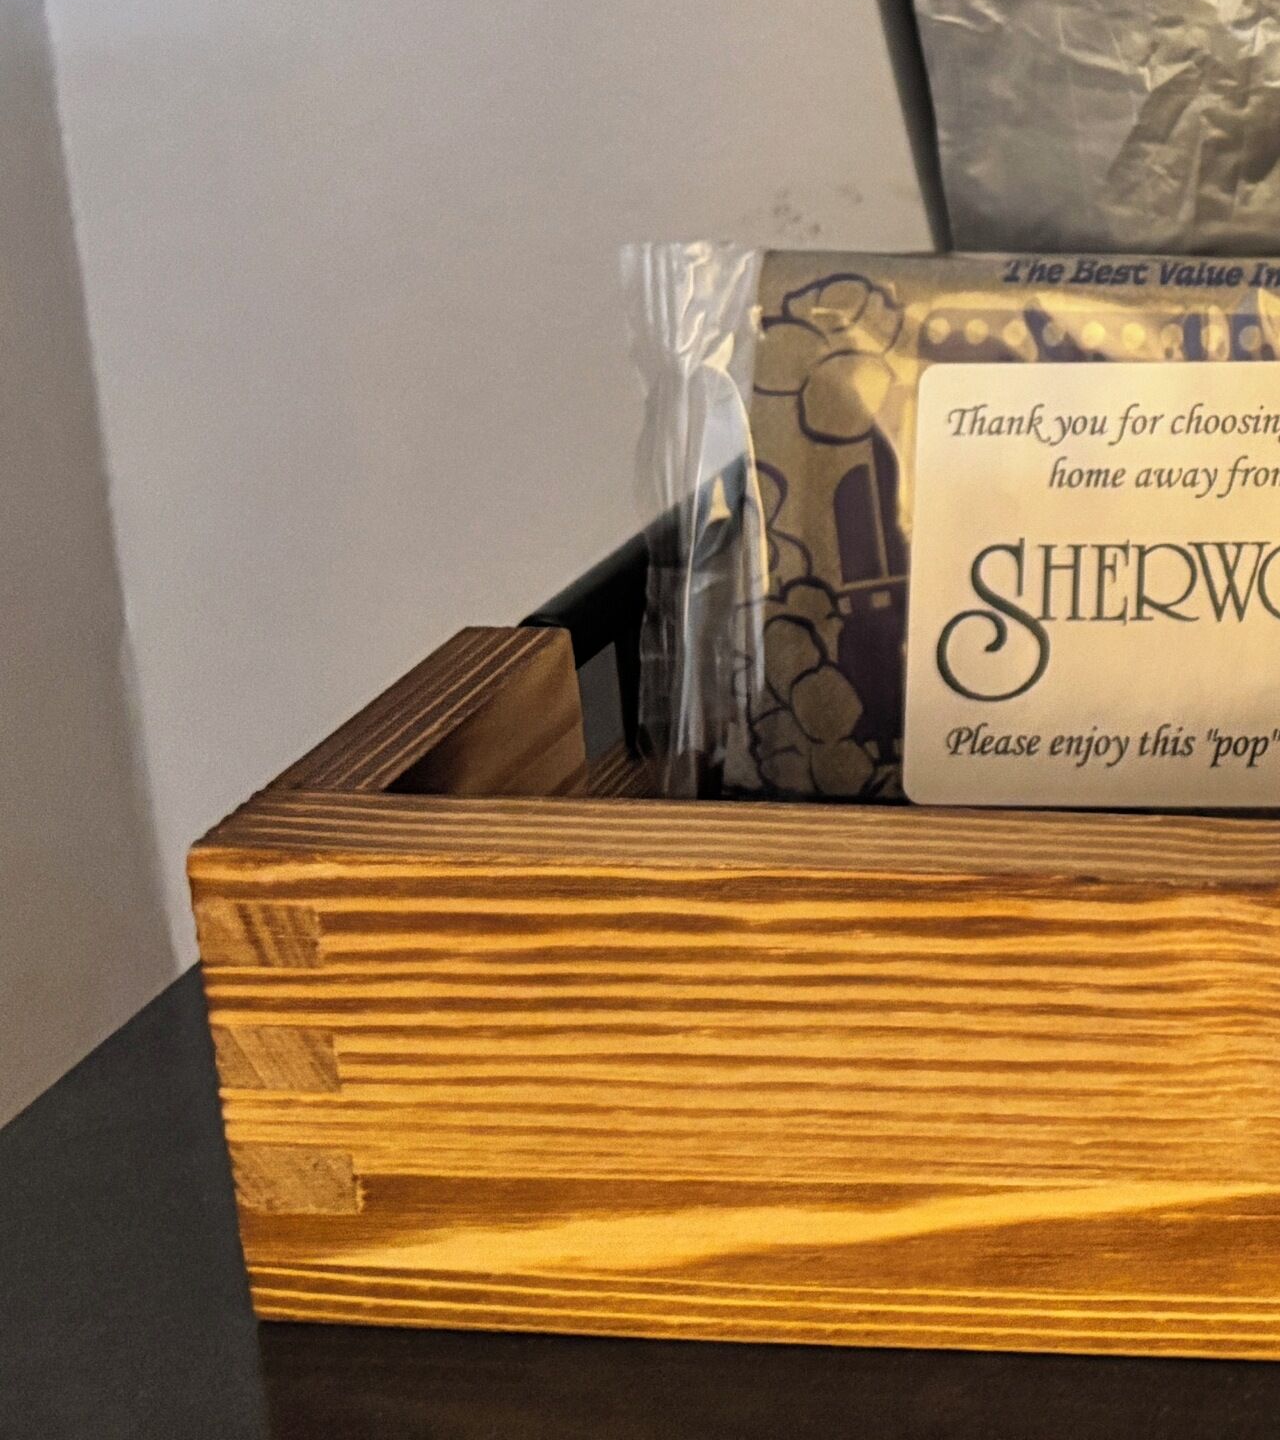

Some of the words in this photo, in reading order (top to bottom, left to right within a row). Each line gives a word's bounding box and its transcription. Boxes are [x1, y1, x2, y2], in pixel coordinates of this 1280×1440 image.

[1002, 259, 1064, 283] The
[1068, 261, 1149, 286] Best
[1158, 262, 1245, 289] Value
[947, 405, 1051, 443] Thank
[1046, 413, 1110, 445] you
[1108, 404, 1164, 445] for
[1048, 455, 1127, 489] home
[1134, 464, 1222, 498] away
[945, 723, 1042, 758] Please
[1048, 726, 1130, 768] enjoy
[1137, 724, 1196, 758] this
